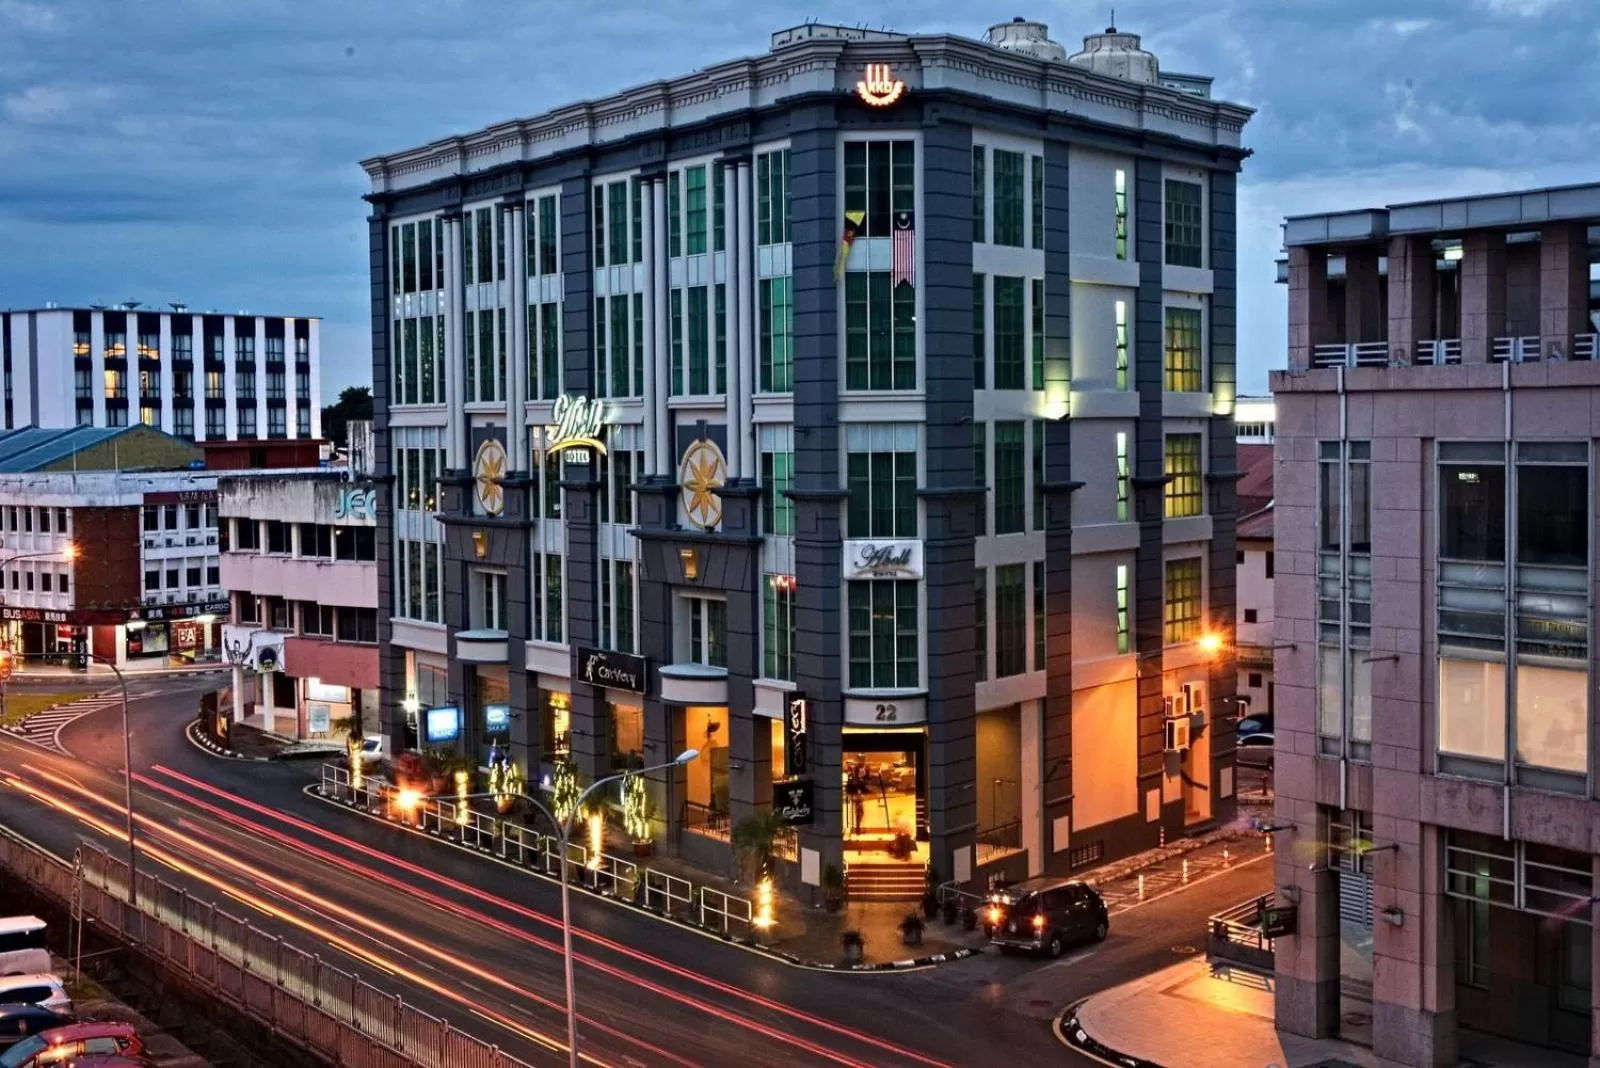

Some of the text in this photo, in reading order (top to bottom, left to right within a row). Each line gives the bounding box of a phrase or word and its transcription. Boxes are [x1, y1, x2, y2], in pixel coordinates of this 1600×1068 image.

[204, 603, 229, 611] CARGO
[875, 704, 897, 721] 22
[1269, 912, 1277, 925] P
